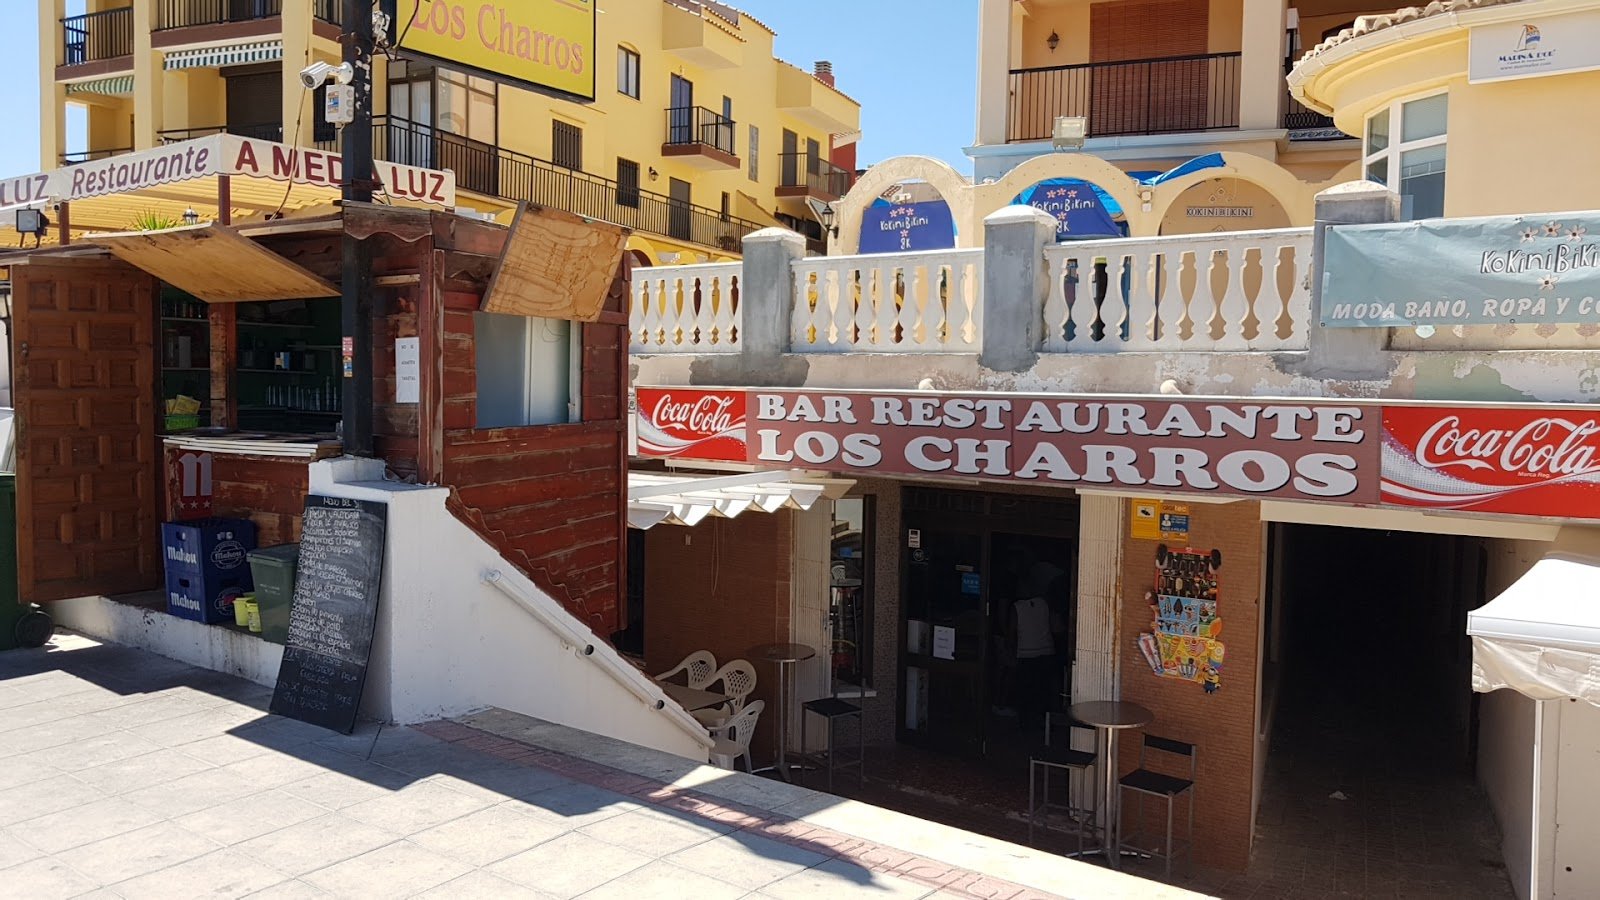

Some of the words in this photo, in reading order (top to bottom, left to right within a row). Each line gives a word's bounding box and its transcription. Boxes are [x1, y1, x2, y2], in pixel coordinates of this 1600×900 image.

[412, 0, 466, 41] Los
[478, 4, 584, 75] Charros
[0, 174, 49, 206] LUZ
[71, 146, 209, 196] Restaurante
[235, 140, 259, 172] A
[272, 145, 382, 191] MED
[391, 166, 445, 201] LUZ
[1332, 303, 1395, 319] MODA
[1482, 298, 1546, 317] ROPA
[1556, 298, 1570, 315] Y
[652, 394, 735, 432] Coca-Cola
[757, 394, 857, 424] BAR
[871, 397, 1364, 443] RESTAURANTE
[757, 429, 882, 467] LOS
[904, 436, 1358, 496] CHARROS
[1416, 415, 1600, 474] Coca-Cola
[167, 546, 197, 564] Mahou
[171, 592, 200, 611] Mahou
